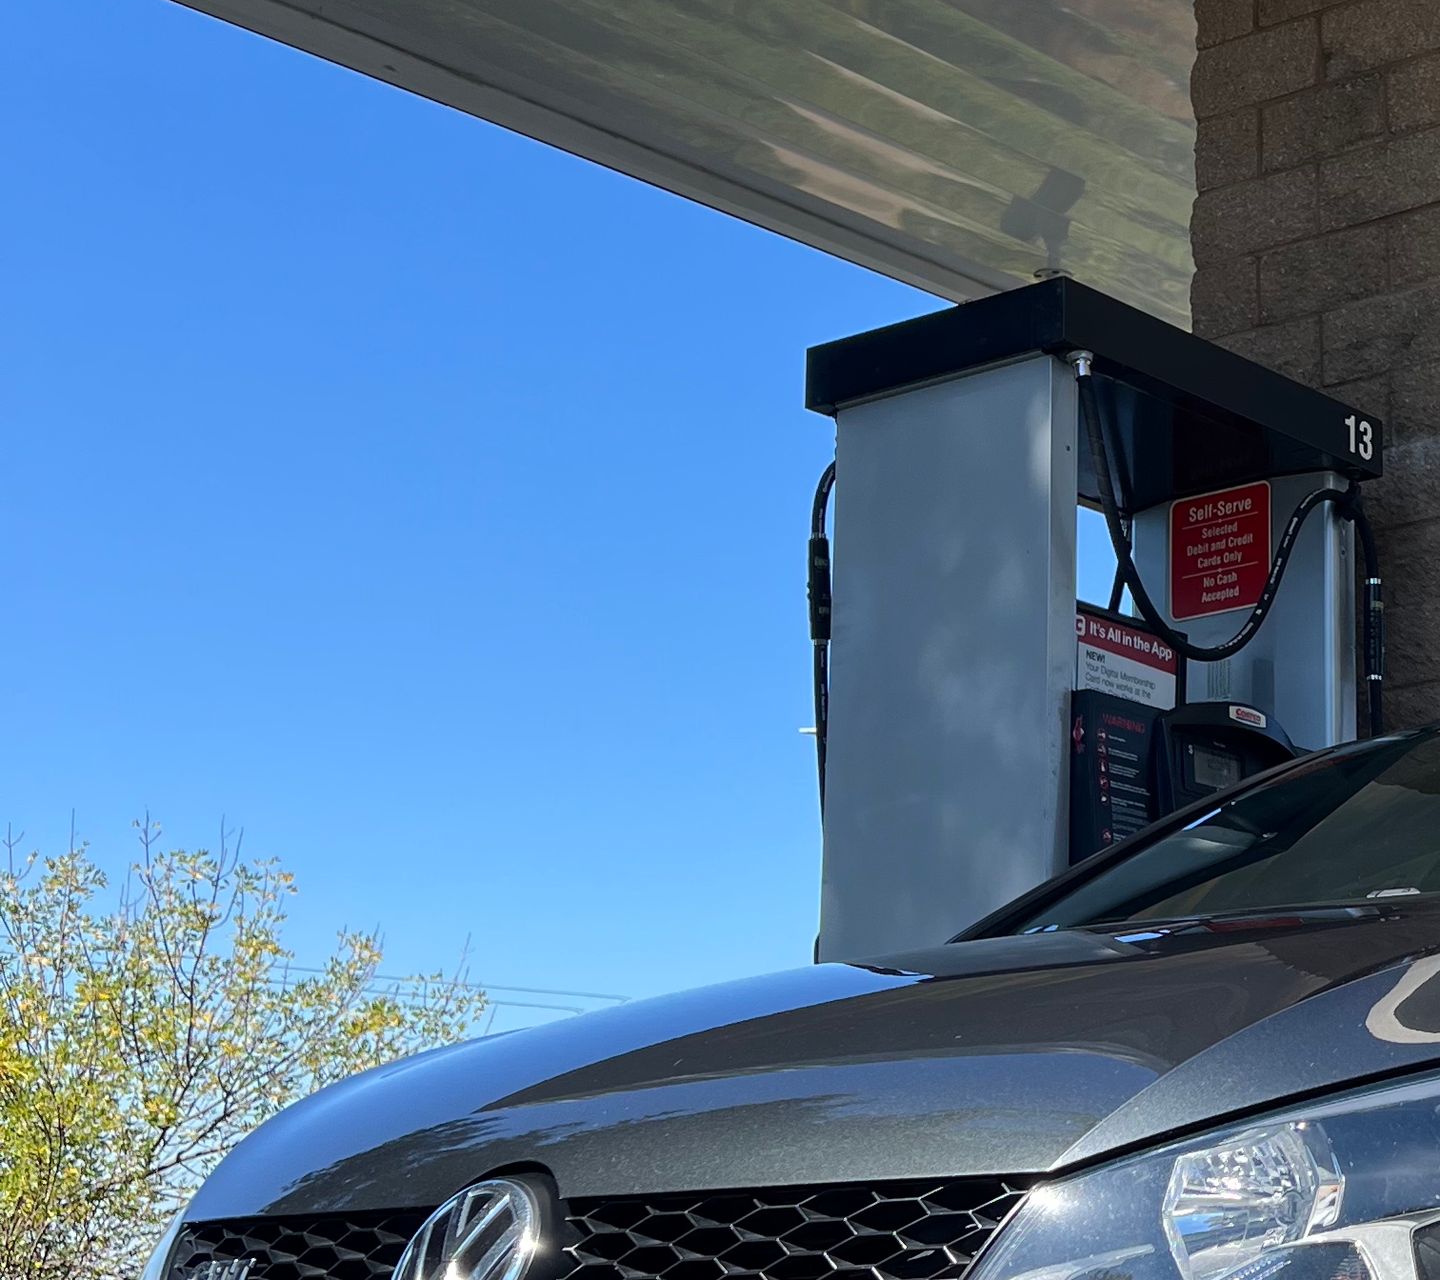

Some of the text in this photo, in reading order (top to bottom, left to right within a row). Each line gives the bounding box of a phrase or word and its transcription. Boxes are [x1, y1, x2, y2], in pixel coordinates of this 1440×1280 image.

[1344, 414, 1372, 461] 13
[1188, 498, 1252, 522] Self-Serve
[1202, 521, 1238, 539] Selected
[1187, 533, 1254, 557] Debit and Credit
[1197, 550, 1243, 569] Cards Only
[1203, 571, 1238, 588] No Cash
[1201, 585, 1240, 603] Accepted
[1089, 620, 1173, 662] It's All in the App
[1086, 649, 1106, 663] NEW!
[1085, 661, 1099, 672] Your
[1102, 713, 1145, 734] WARNING
